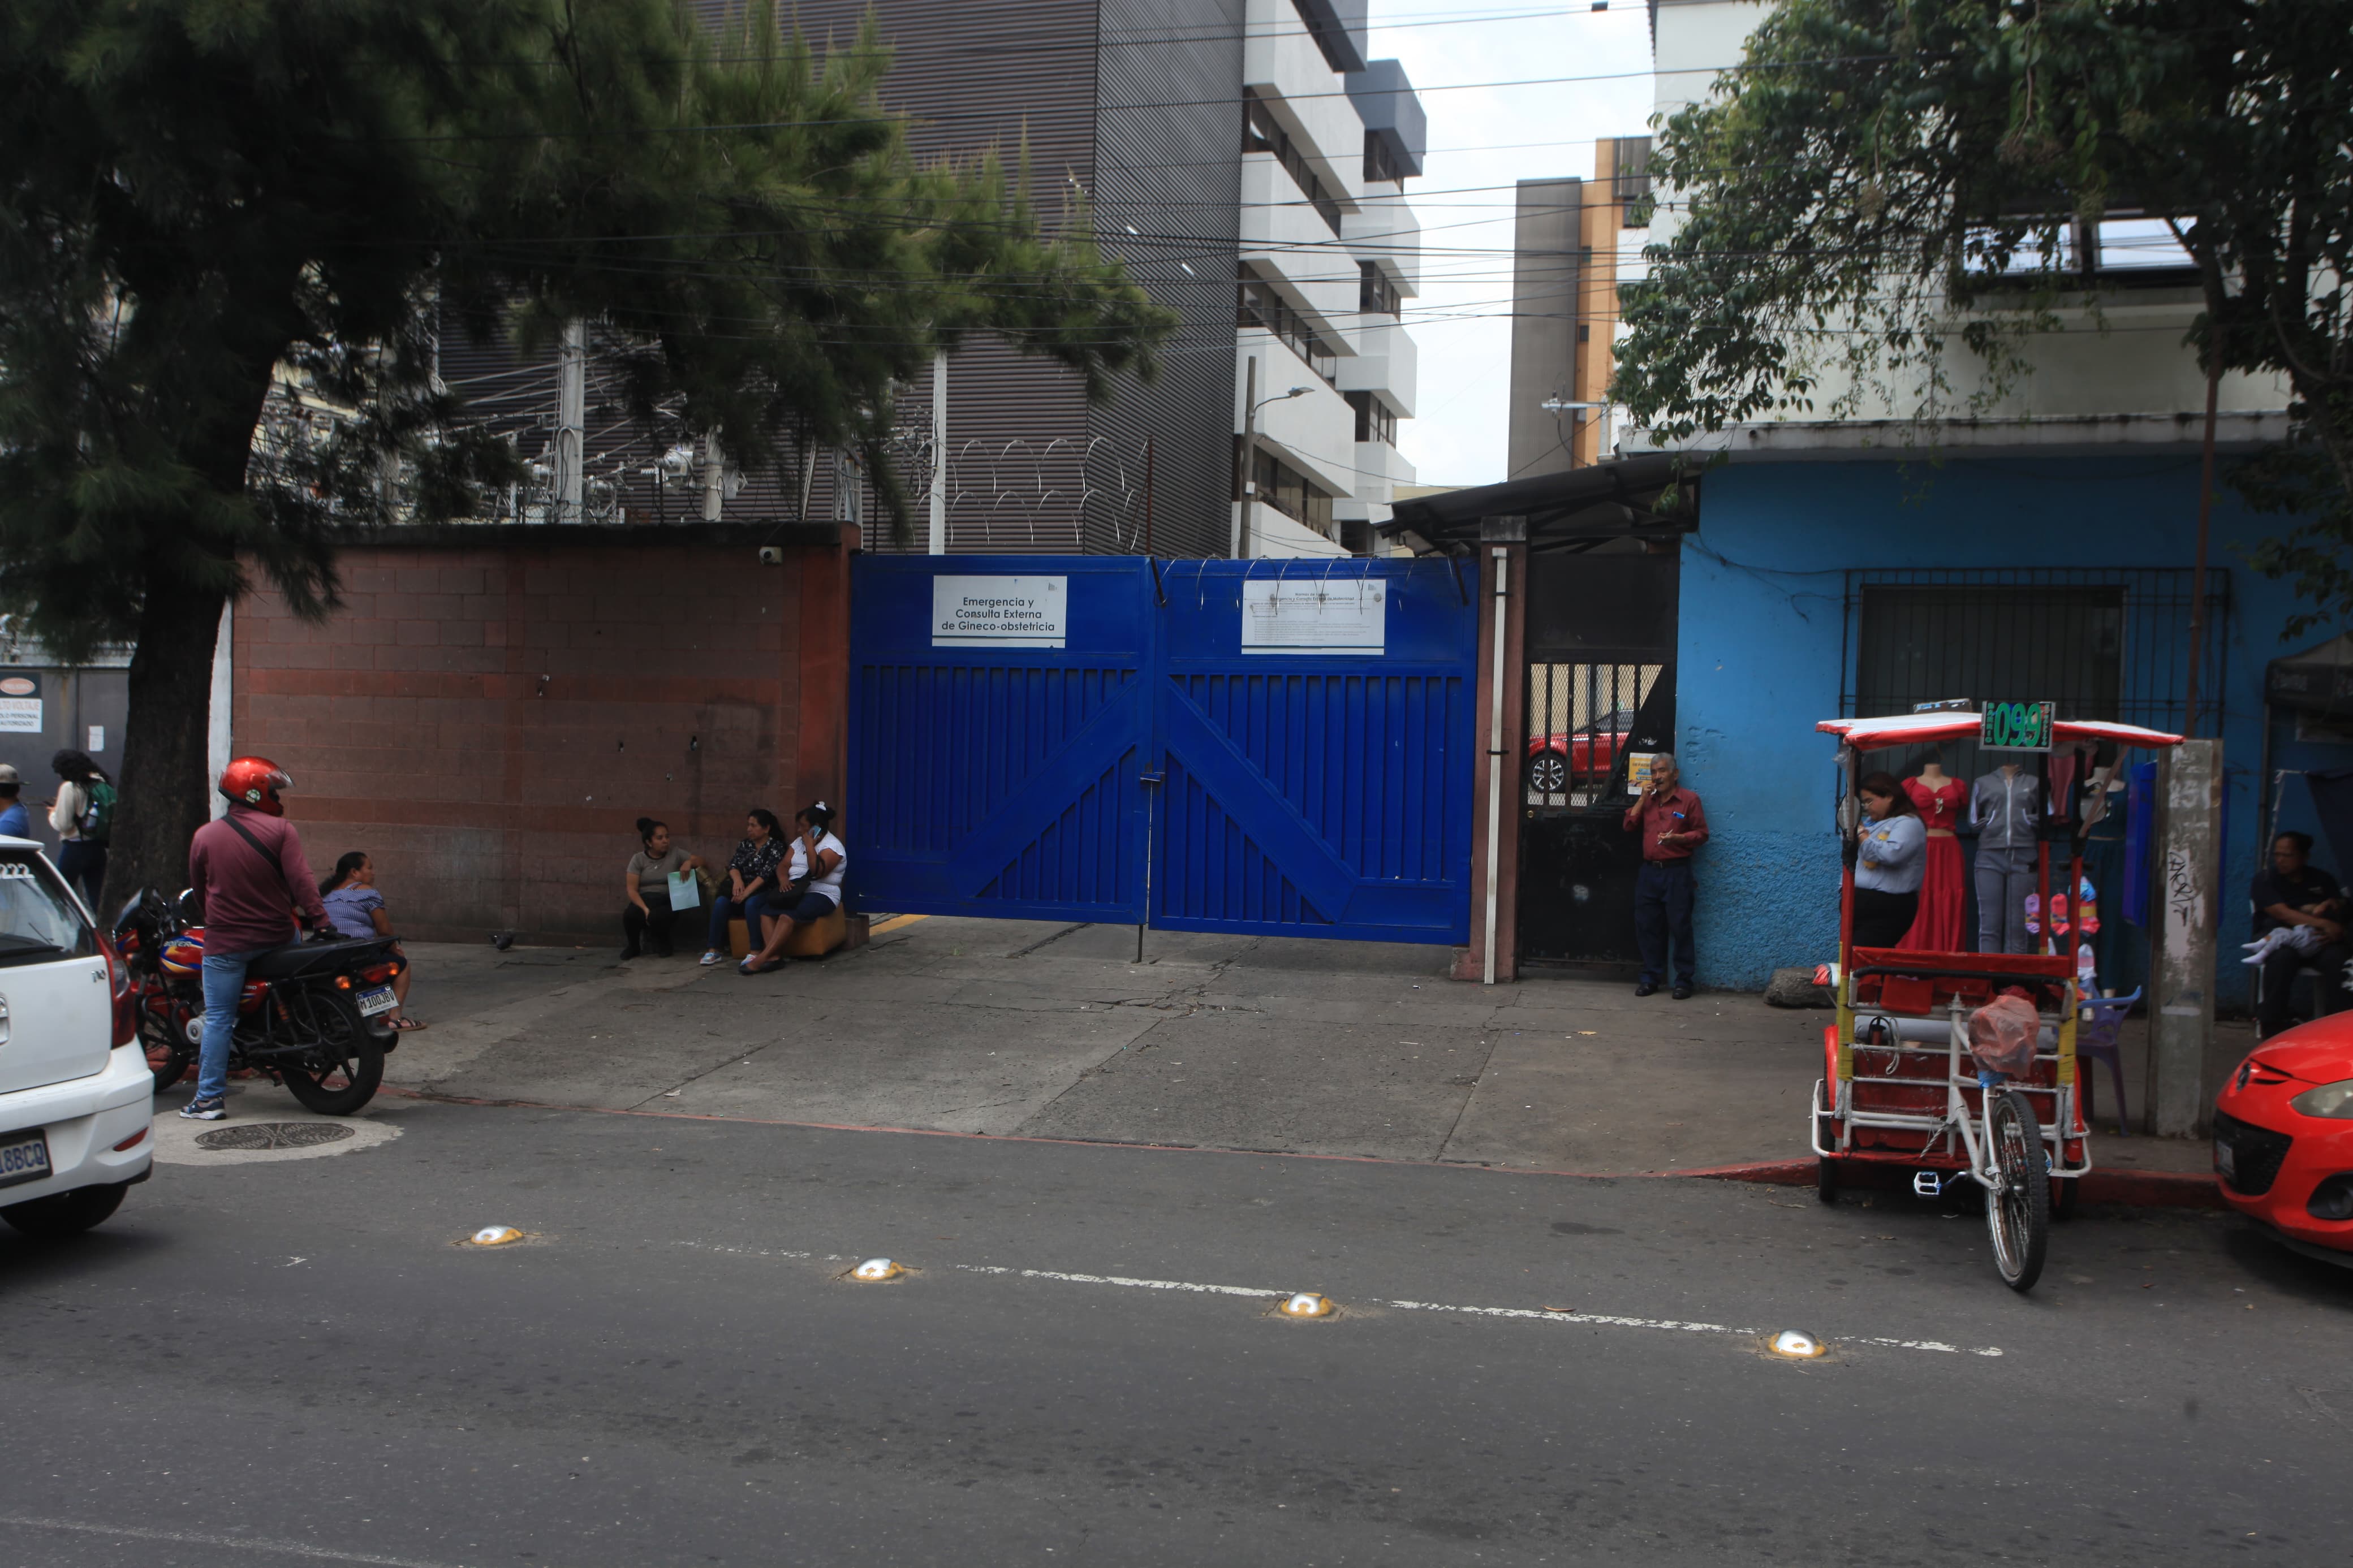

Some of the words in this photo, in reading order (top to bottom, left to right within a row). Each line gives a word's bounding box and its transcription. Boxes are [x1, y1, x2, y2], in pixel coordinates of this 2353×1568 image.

[963, 597, 1025, 608] Emergencia
[1028, 599, 1034, 608] y
[956, 609, 1000, 619] Consulta
[1004, 610, 1042, 619] Externa
[942, 621, 955, 630] de
[959, 621, 1055, 631] Gineco-obstetricia
[1993, 702, 2041, 748] 099
